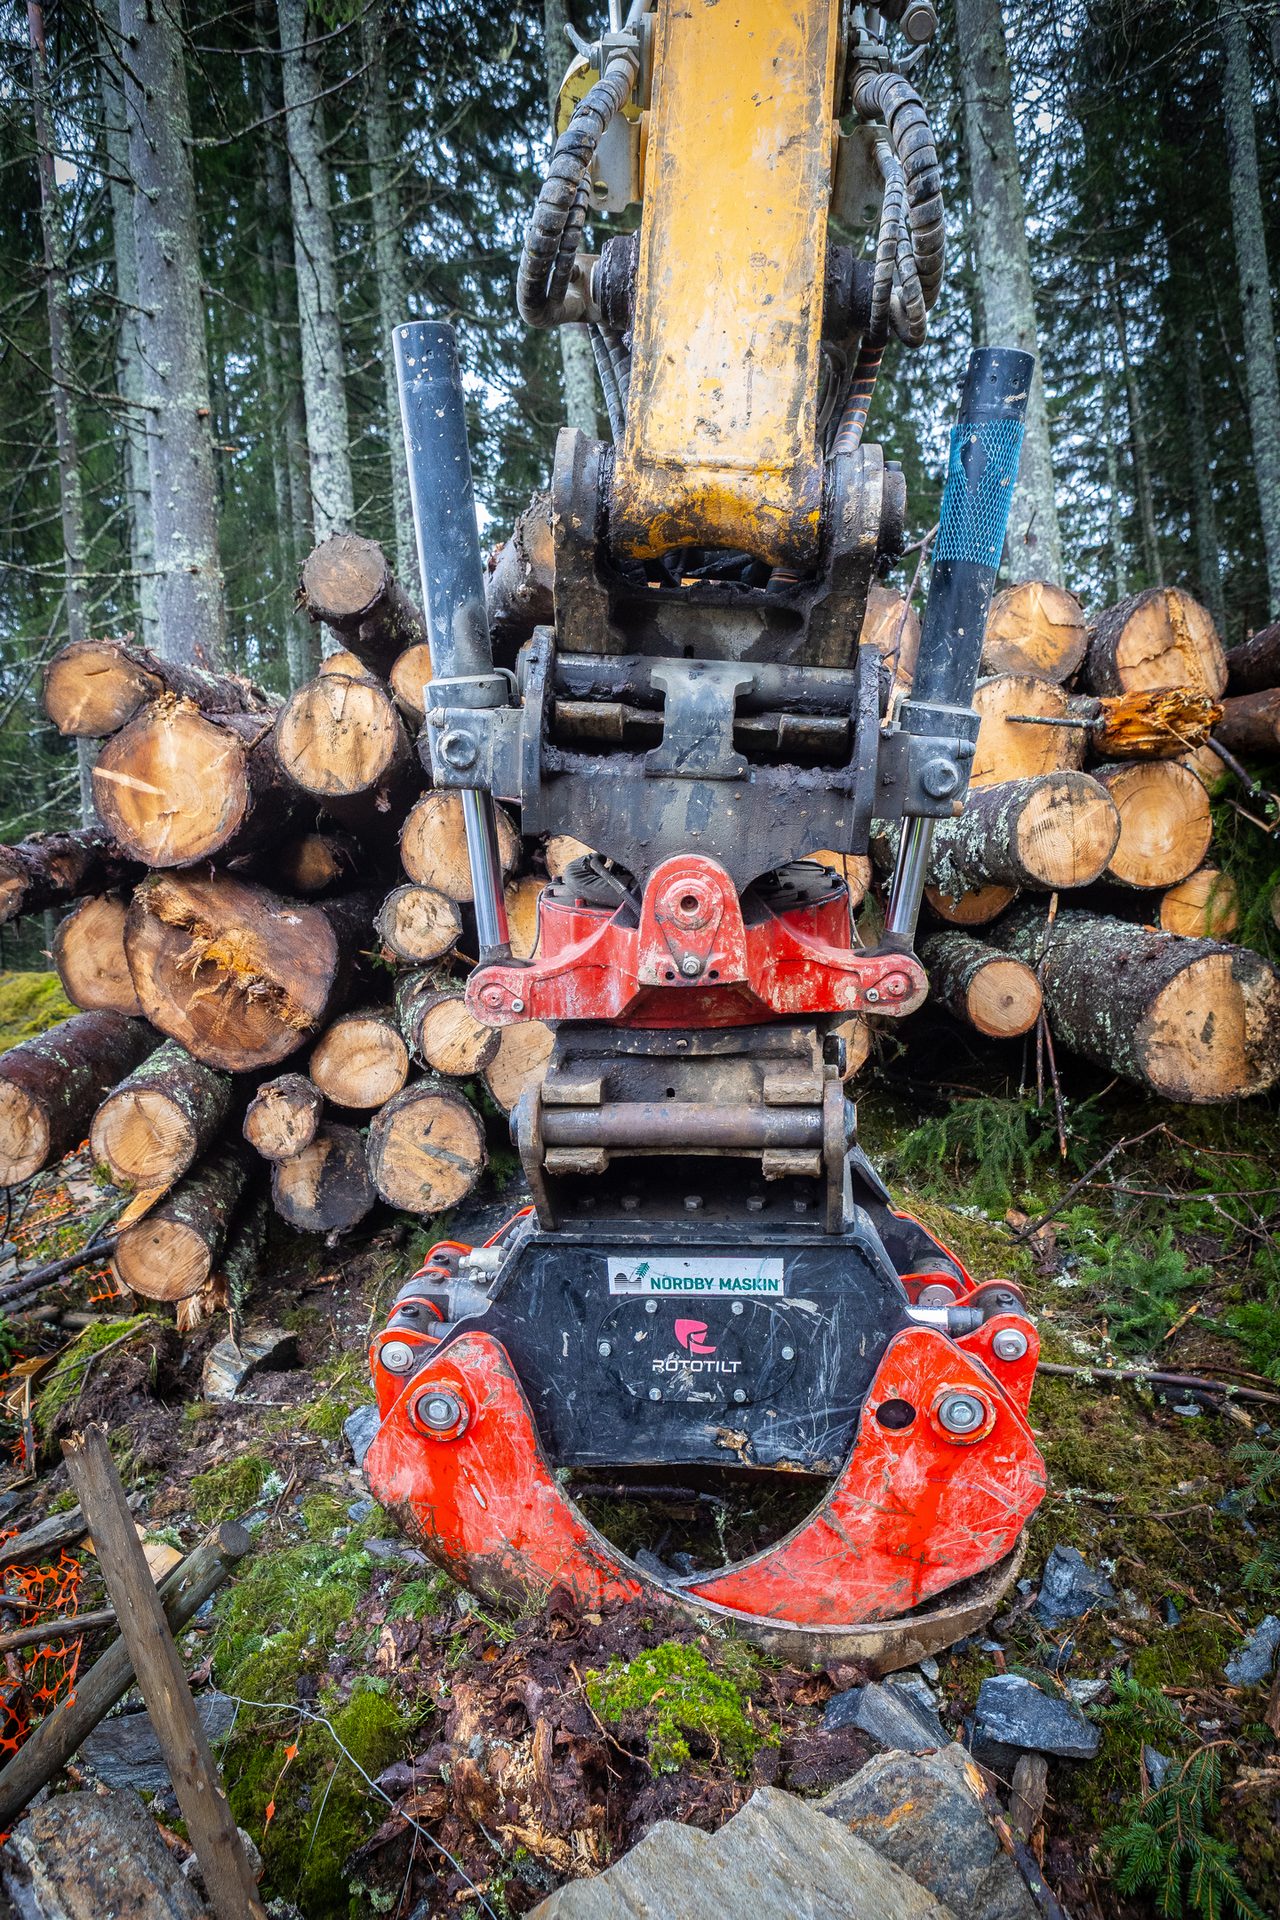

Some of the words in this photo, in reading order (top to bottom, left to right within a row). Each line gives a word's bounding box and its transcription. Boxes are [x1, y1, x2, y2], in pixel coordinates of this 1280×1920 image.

[650, 1277, 714, 1290] NORDBY
[719, 1278, 778, 1291] MASKIN
[652, 1360, 742, 1373] ROTOTILT
